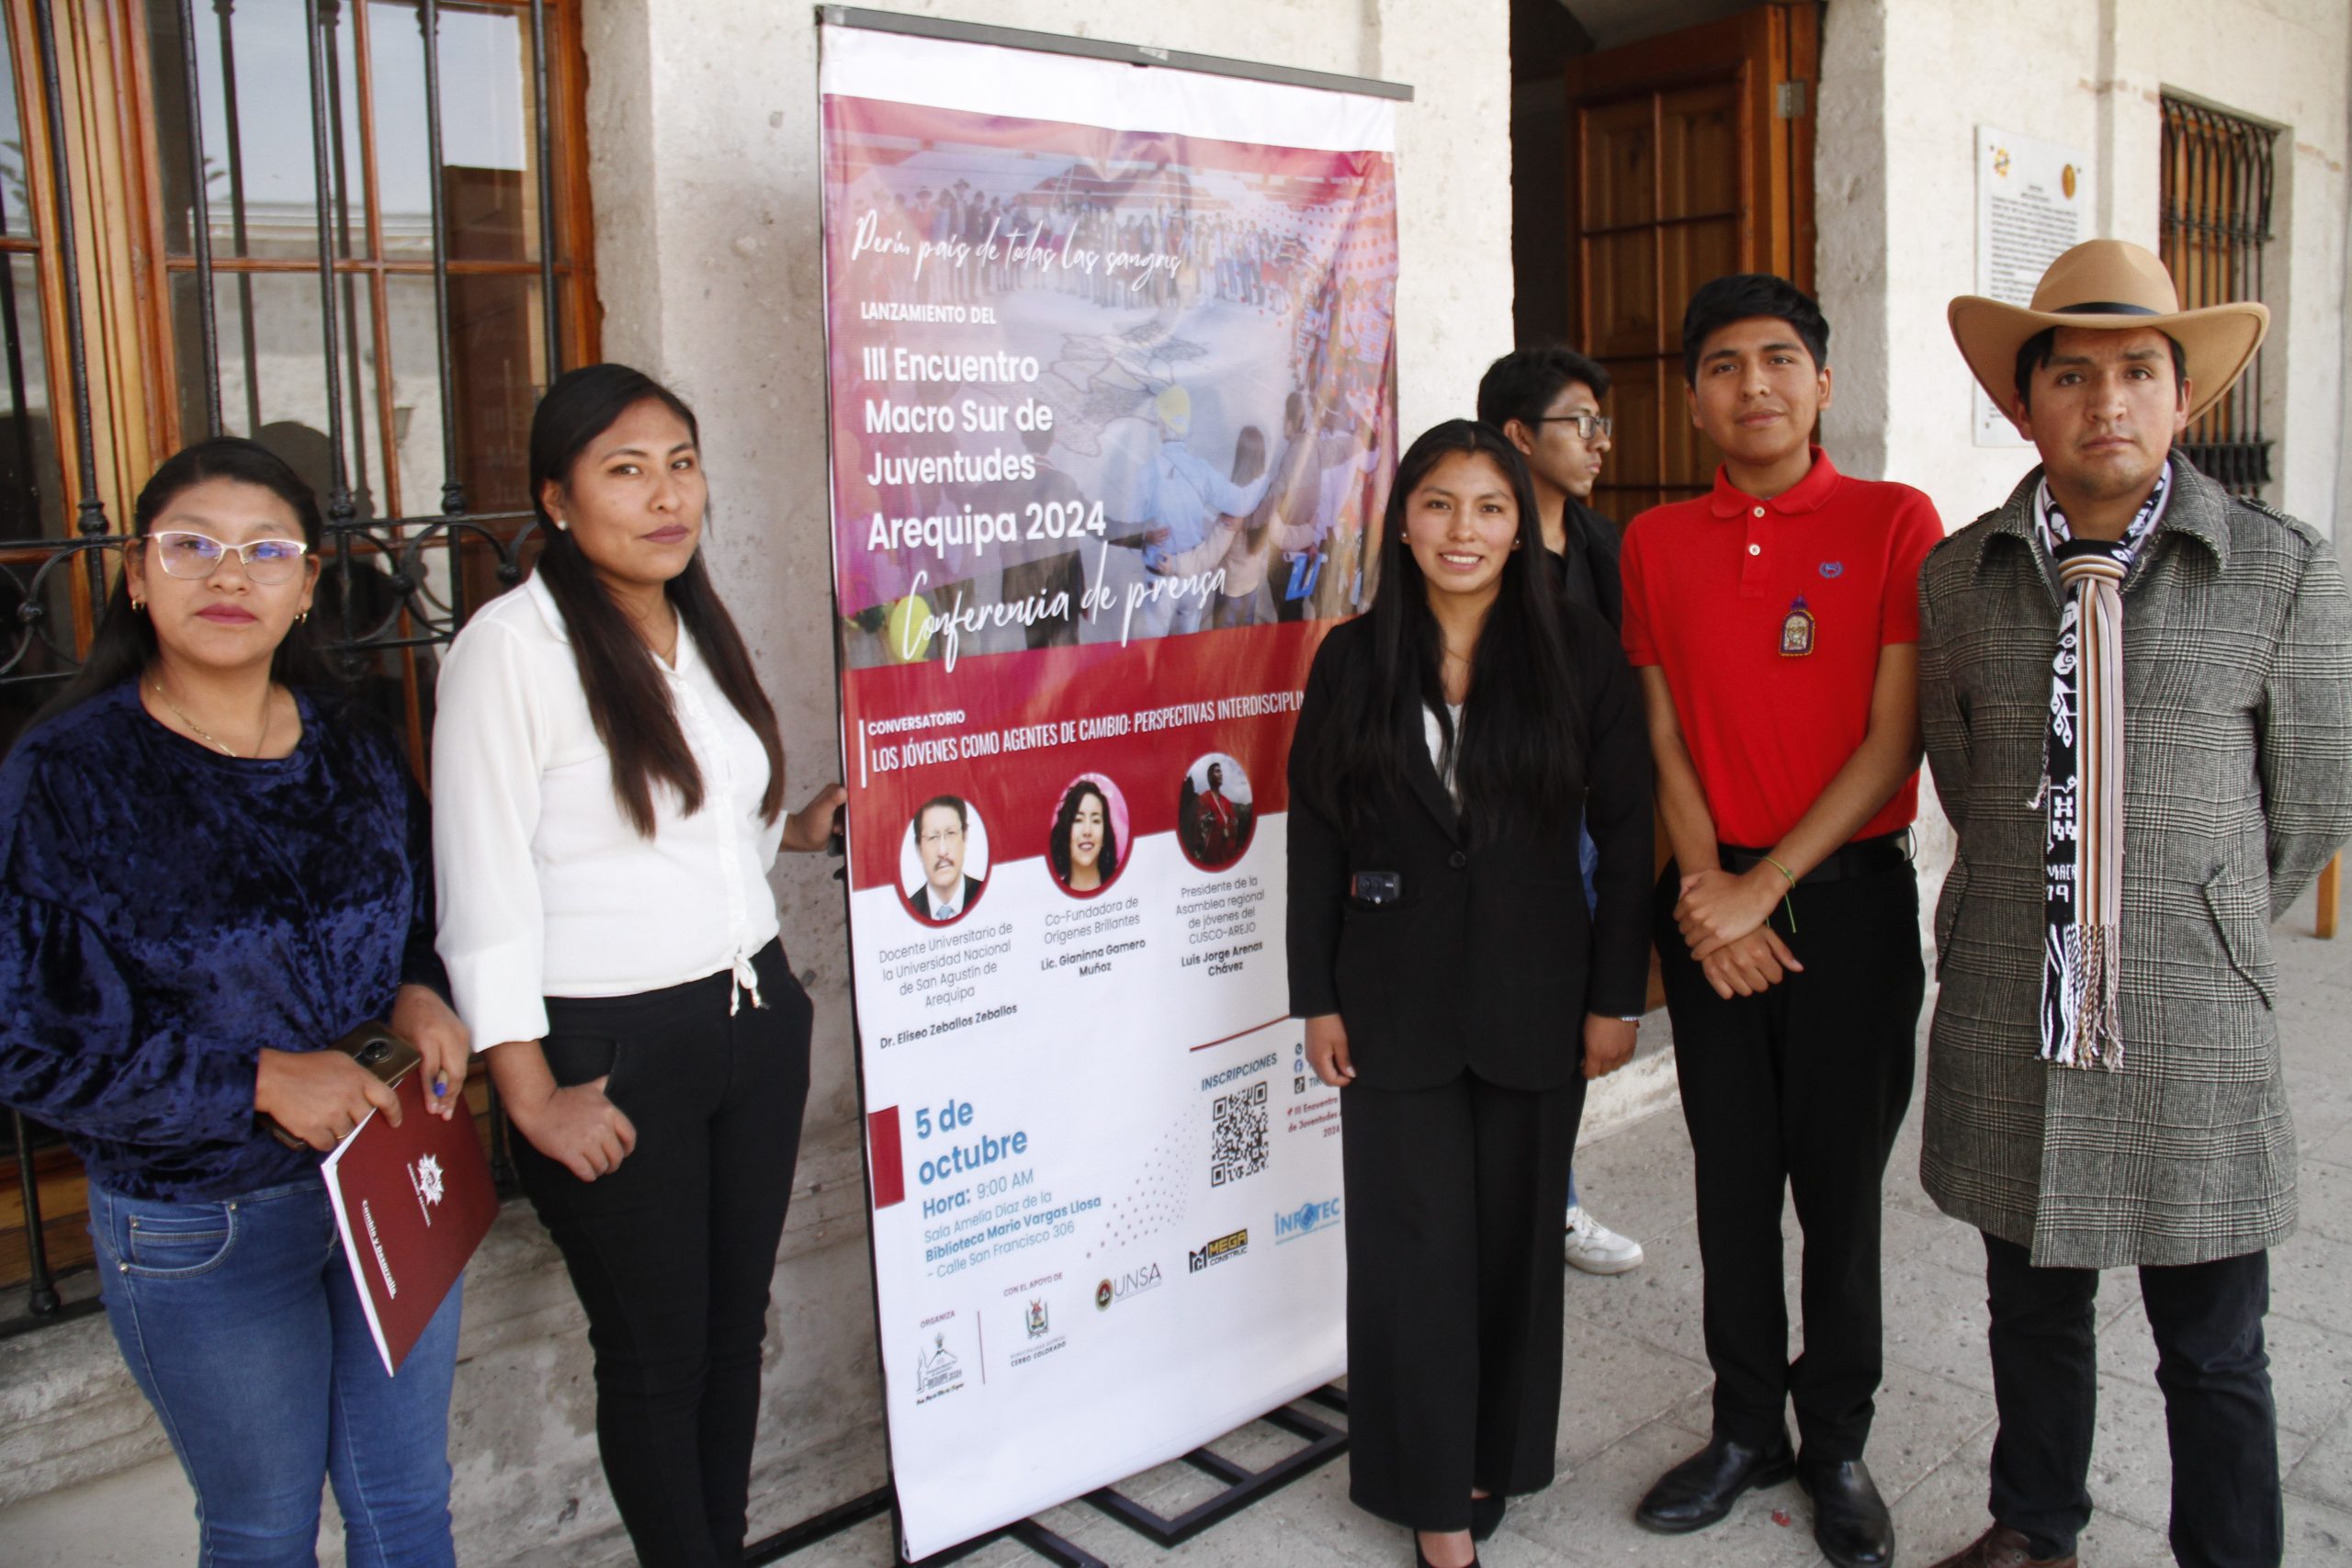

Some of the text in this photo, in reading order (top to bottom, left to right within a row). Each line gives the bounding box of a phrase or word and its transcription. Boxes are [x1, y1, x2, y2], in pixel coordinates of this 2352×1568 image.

[913, 234, 970, 282] país
[976, 217, 1000, 267] de
[1105, 247, 1182, 291] sangres
[861, 301, 997, 324] LANZAMIENTO DEL
[864, 347, 1039, 382] III Encuentro
[865, 398, 1053, 433] Macro Sur de
[867, 447, 1036, 486] Juventudes
[867, 501, 1106, 559] Arequipa 2024
[903, 540, 1226, 673] Conferencia de prensa
[868, 710, 966, 736] CONVERSATORIO
[873, 746, 899, 772] LOS
[902, 738, 958, 768] JÓVENES
[961, 731, 1000, 759] COMO
[1002, 723, 1057, 752] AGENTES
[1060, 721, 1076, 743] DE
[1079, 714, 1132, 740] CAMBIO:
[1134, 701, 1215, 733] PERSPECTIVAS
[1176, 888, 1264, 916] Asamblea regional
[1181, 876, 1258, 898] Presidente de la
[1045, 897, 1139, 927] Co-Fundadora de
[1094, 914, 1141, 934] Brillantes
[1188, 919, 1201, 929] de
[1241, 906, 1256, 919] del
[878, 922, 1012, 964] Docente Universitario de
[1189, 921, 1256, 944] CUSCO-AREJO
[883, 939, 1012, 982] la Universidad Nacional
[1041, 939, 1147, 971] Lic. Gianinna Gamero
[1079, 962, 1112, 977] Muñoz
[1182, 942, 1264, 967] Luis Jorge Arenas
[1208, 961, 1244, 976] Chávez
[899, 983, 913, 996] de
[916, 976, 937, 991] San
[983, 962, 998, 975] de
[925, 986, 975, 1009] Arequipa
[880, 1003, 1018, 1049] Dr. Eliseo Zeballos Zeballos
[1202, 1053, 1278, 1091] INSCRIPCIONES
[916, 1100, 974, 1139] 5 de
[919, 1131, 1028, 1185] octubre
[922, 1168, 1034, 1220] Hora: 9:00 AM
[924, 1225, 951, 1245] Sala
[954, 1210, 992, 1234] Amelia
[1022, 1195, 1037, 1209] de
[1040, 1190, 1052, 1203] la
[925, 1197, 1102, 1263] Biblioteca Mario Vargas Llosa
[937, 1258, 967, 1280] Calle
[969, 1248, 991, 1267] San
[993, 1229, 1050, 1258] Francisco
[1053, 1220, 1075, 1238] 306
[1209, 1231, 1248, 1258] MEGA
[1210, 1247, 1249, 1266] CONSTRUC
[1003, 1271, 1064, 1297] CON EL APOYO DE
[1114, 1262, 1161, 1297] UNSA
[920, 1310, 956, 1329] ORGANIZA
[1011, 1355, 1032, 1367] CERRO
[1034, 1340, 1067, 1359] COLORADO
